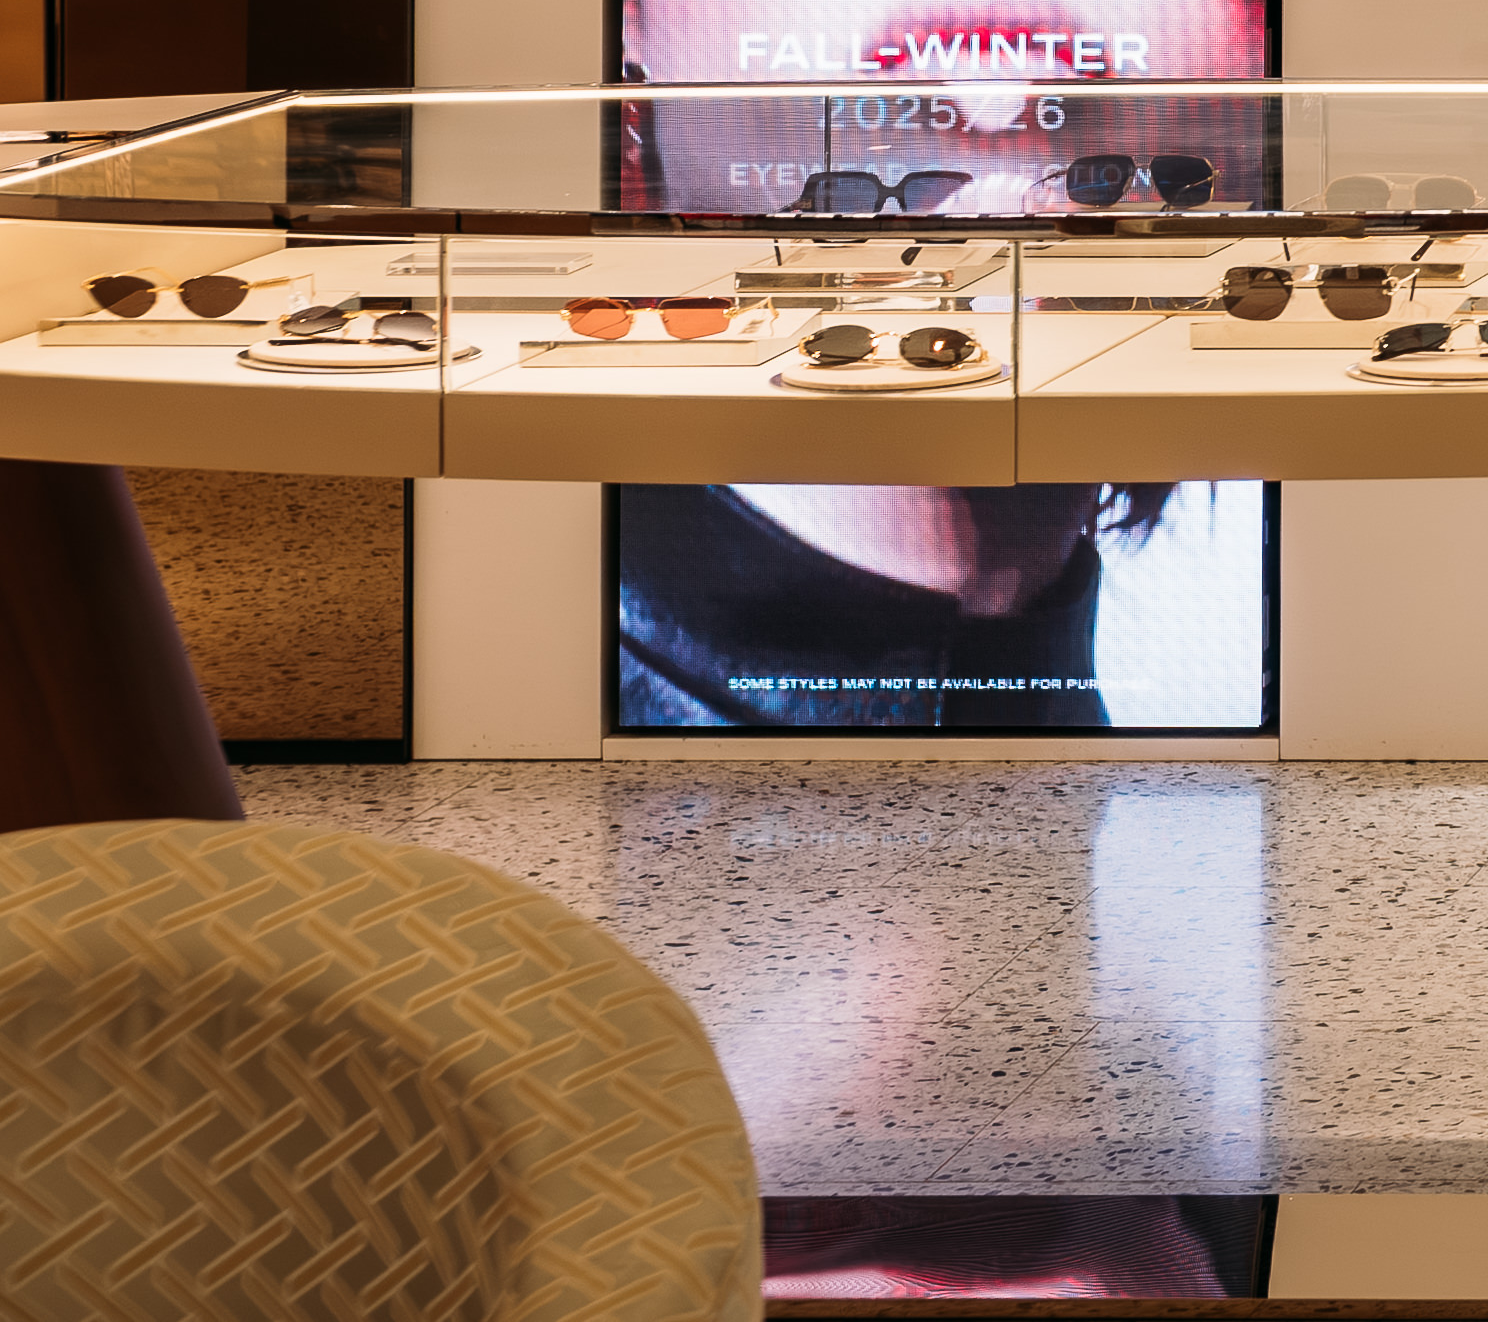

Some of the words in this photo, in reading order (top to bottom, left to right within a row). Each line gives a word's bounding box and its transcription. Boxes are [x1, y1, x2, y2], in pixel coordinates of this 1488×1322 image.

[738, 33, 1150, 72] FALL-WINTER
[728, 677, 774, 691] SOME
[778, 677, 838, 691] STYLES
[842, 677, 875, 691] MAY
[880, 677, 912, 691] NOT
[917, 677, 937, 691] BE
[942, 677, 1025, 691] AVAILABLE
[1030, 677, 1061, 691] FOR
